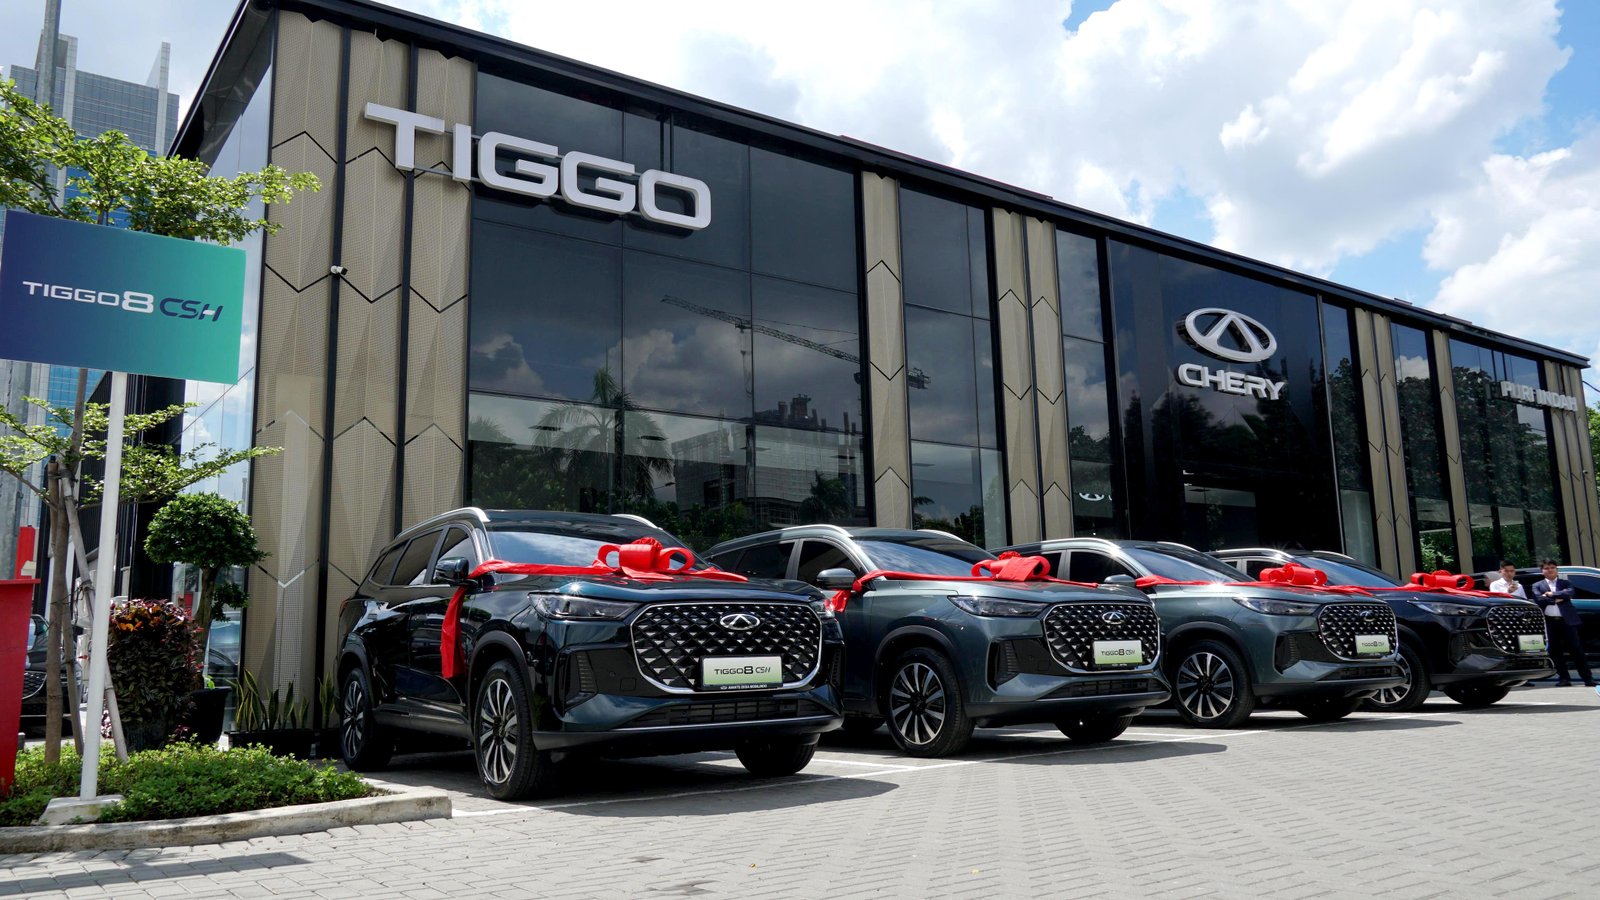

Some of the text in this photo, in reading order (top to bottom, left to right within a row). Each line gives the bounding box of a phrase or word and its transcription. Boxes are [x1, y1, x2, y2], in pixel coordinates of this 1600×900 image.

[364, 102, 712, 231] TIGGO
[159, 297, 224, 322] CSH
[1178, 363, 1285, 400] CHERY
[1500, 381, 1578, 412] PURI INDAH
